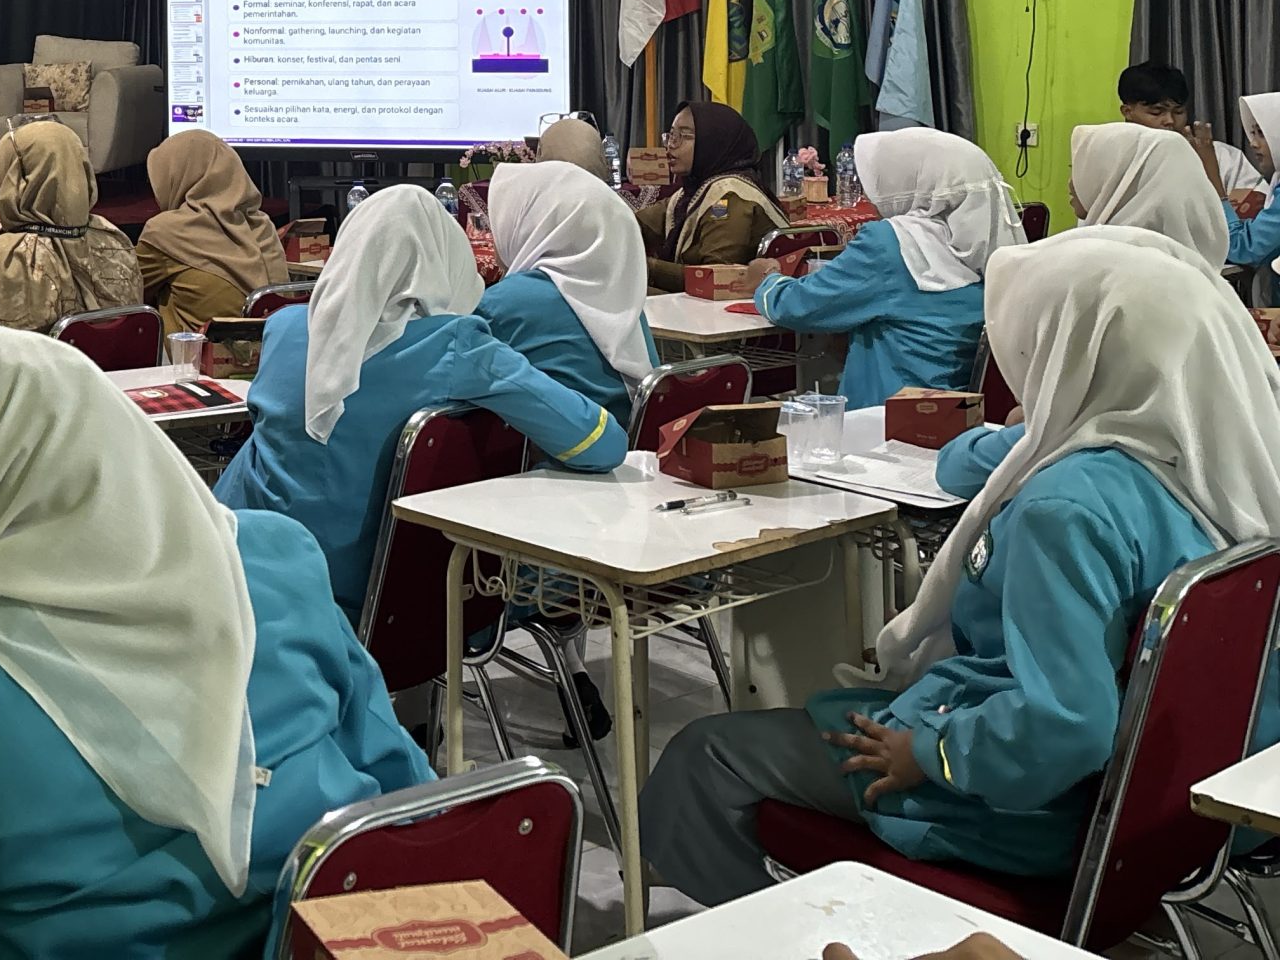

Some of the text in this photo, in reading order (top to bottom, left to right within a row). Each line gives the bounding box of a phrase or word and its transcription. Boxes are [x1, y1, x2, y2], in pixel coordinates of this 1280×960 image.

[273, 0, 307, 9] seminar,
[308, 0, 351, 9] konferensi,
[352, 0, 375, 9] rapat,
[376, 0, 392, 8] dan
[243, 10, 299, 19] pemerintahan.
[288, 26, 327, 36] gathering,
[328, 26, 368, 36] launching,
[370, 26, 385, 35] dan
[386, 26, 422, 36] kegiatan
[243, 37, 285, 45] komunitas.
[277, 55, 305, 64] konser,
[306, 55, 337, 64] festival,
[338, 55, 354, 63] dan
[355, 56, 382, 64] pentas
[281, 78, 326, 87] pernikahan,
[327, 78, 350, 87] ulang
[351, 78, 376, 86] tahun,
[377, 78, 392, 86] dan
[394, 79, 431, 87] perayaan
[244, 105, 284, 113] Sesuaikan
[285, 105, 311, 114] pilihan
[312, 105, 331, 114] kata,
[361, 106, 377, 114] dan
[378, 106, 411, 115] protokol
[413, 106, 443, 115] dengan
[244, 115, 275, 123] konteks
